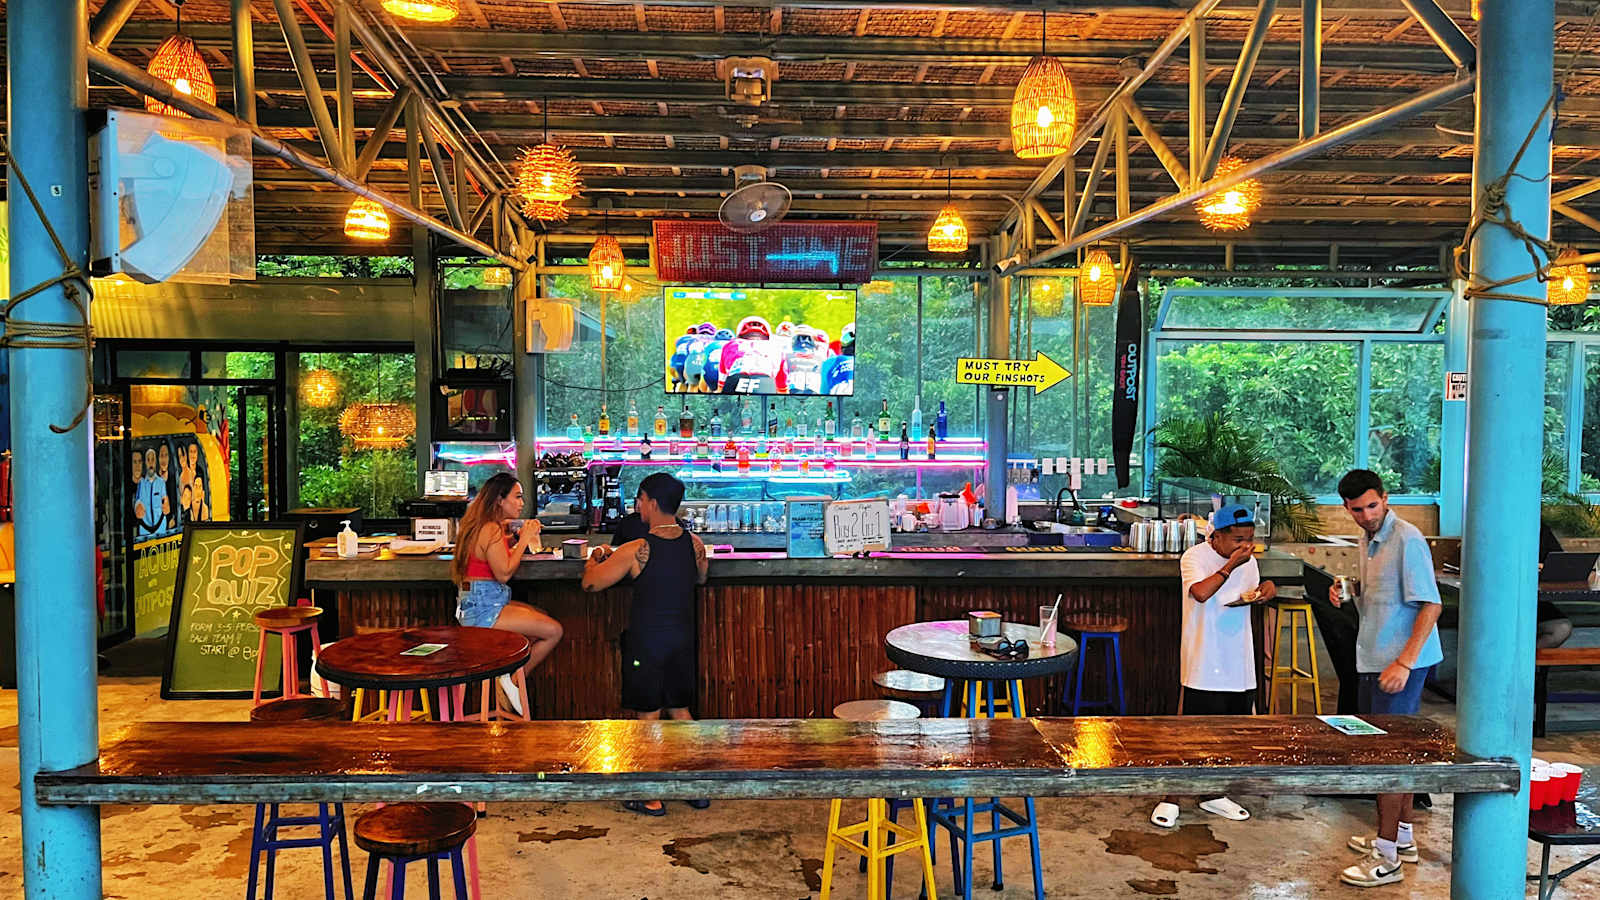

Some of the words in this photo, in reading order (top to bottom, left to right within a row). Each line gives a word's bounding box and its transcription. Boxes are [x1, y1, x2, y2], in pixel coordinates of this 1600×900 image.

[662, 235, 765, 270] JUST
[964, 372, 990, 381] OUR
[996, 373, 1045, 383] FINSHOTS
[965, 361, 999, 371] MUST
[1005, 362, 1030, 371] TRY
[1126, 343, 1138, 401] OUTPOST
[735, 378, 761, 393] EF
[851, 511, 859, 538] 2
[211, 545, 279, 582] POP
[207, 576, 278, 605] QUIZ
[200, 644, 227, 656] START
